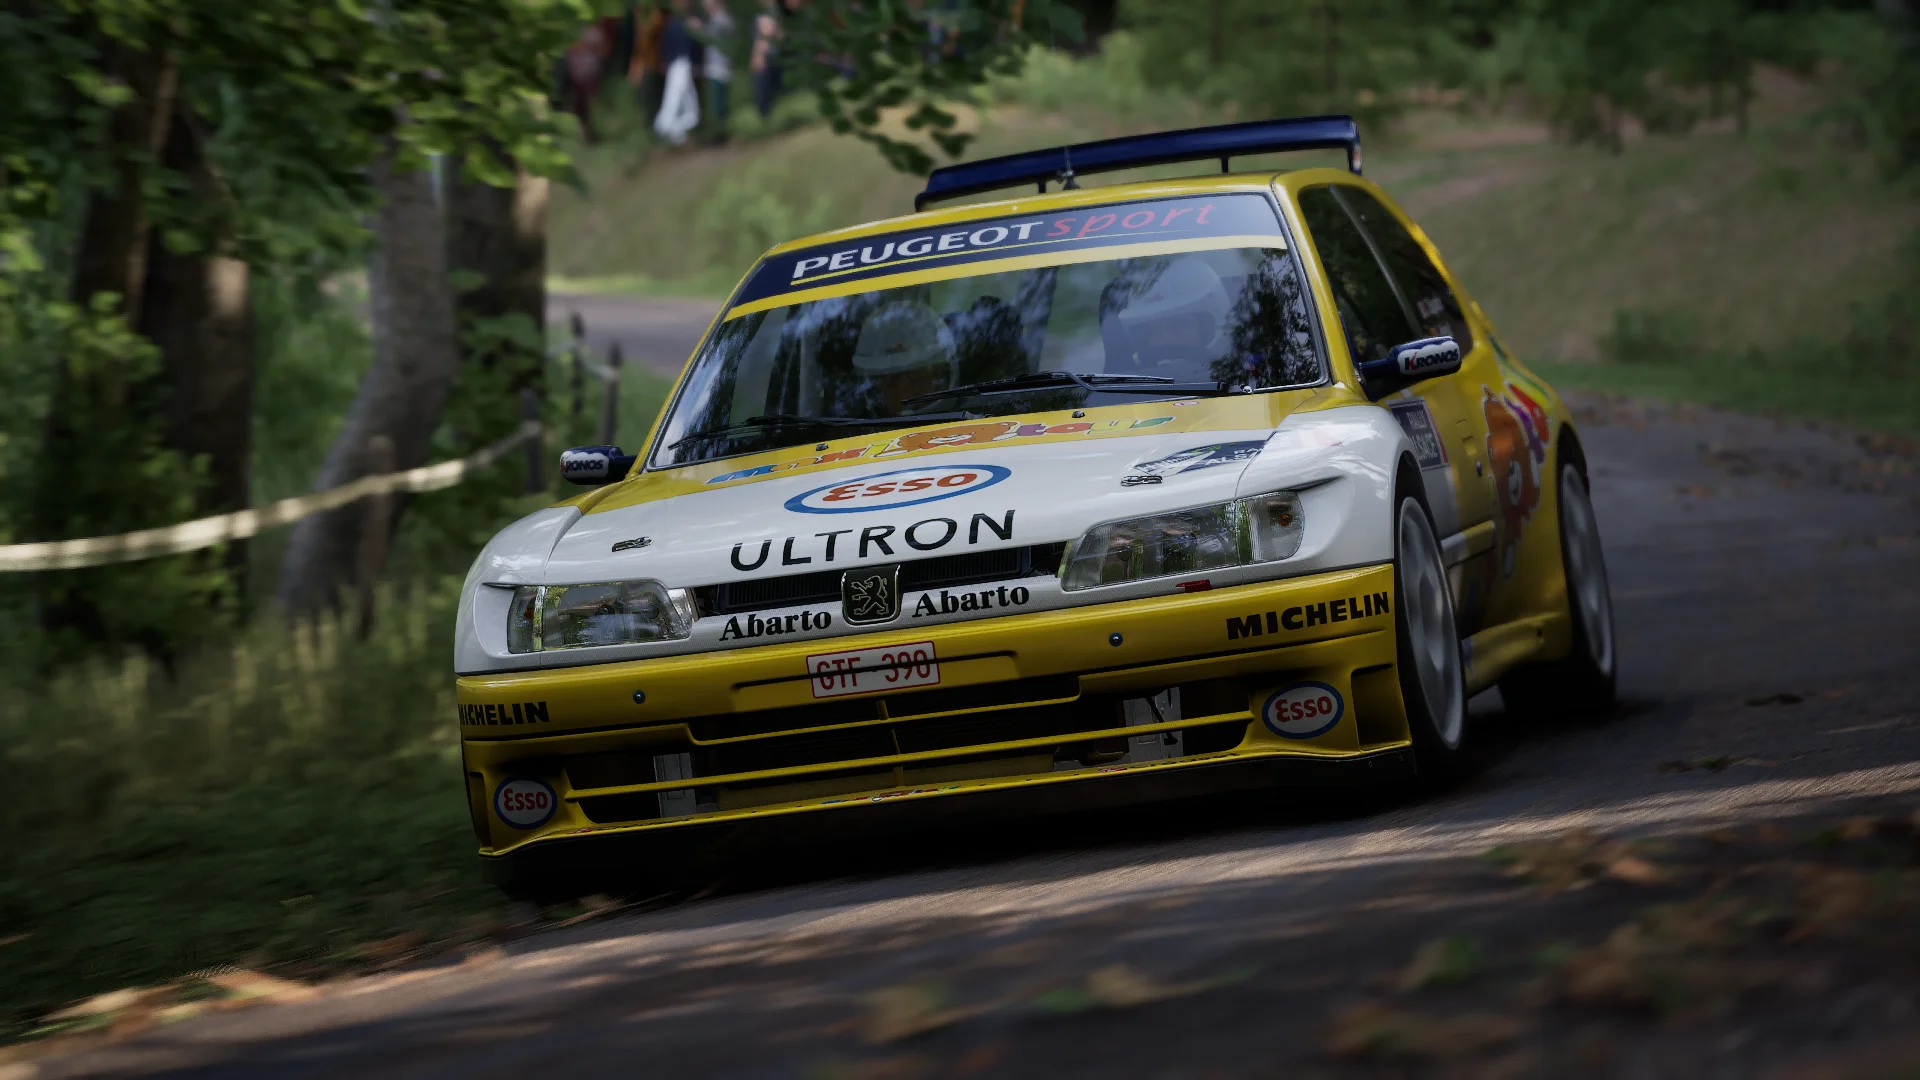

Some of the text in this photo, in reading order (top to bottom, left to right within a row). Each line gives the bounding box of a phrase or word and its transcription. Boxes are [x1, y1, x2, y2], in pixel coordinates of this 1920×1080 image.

[792, 203, 1217, 279] PEUGEOT sport
[1404, 348, 1459, 371] KRONOS
[1016, 416, 1176, 436] toys
[730, 510, 1016, 571] ULTRON
[912, 583, 1030, 618] Abarto
[1225, 591, 1390, 640] MICHELIN
[718, 609, 832, 642] Abarto
[816, 649, 931, 691] GTF 390
